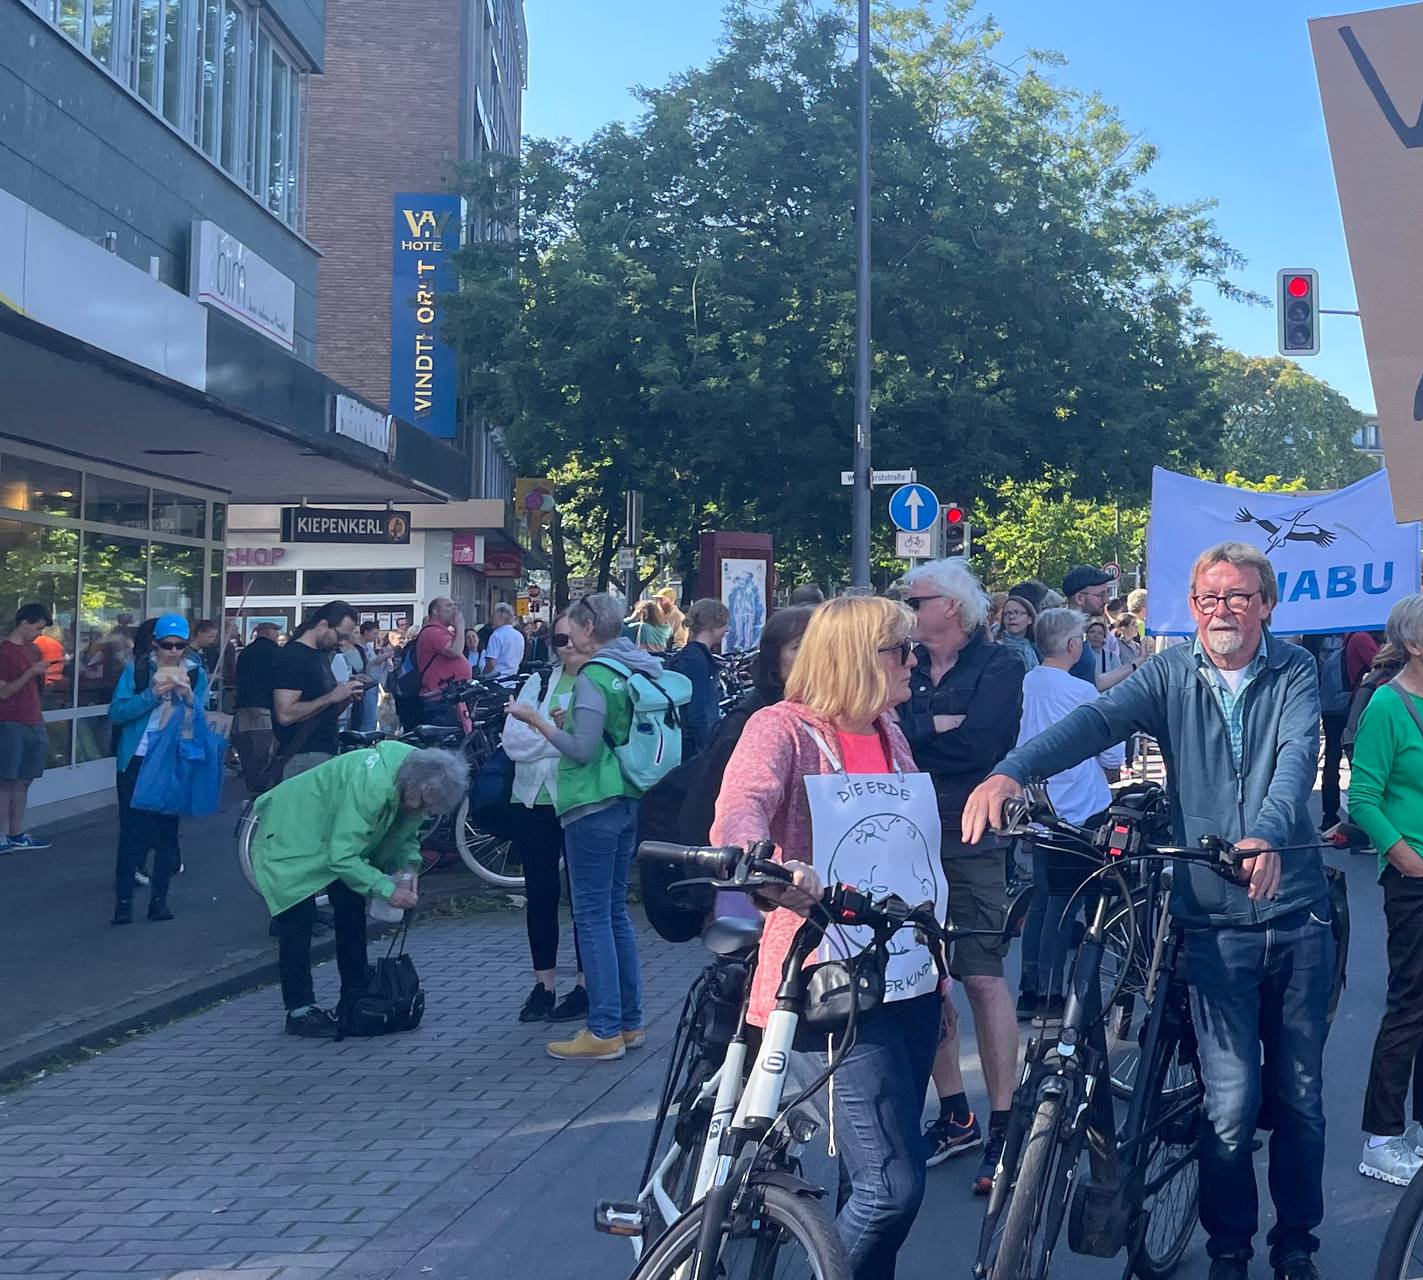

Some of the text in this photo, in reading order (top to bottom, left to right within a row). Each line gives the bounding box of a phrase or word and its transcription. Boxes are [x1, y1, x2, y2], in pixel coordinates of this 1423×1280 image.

[402, 240, 446, 251] HOTE
[297, 517, 384, 535] KIEPENKERL
[837, 781, 912, 804] DIE ERDE
